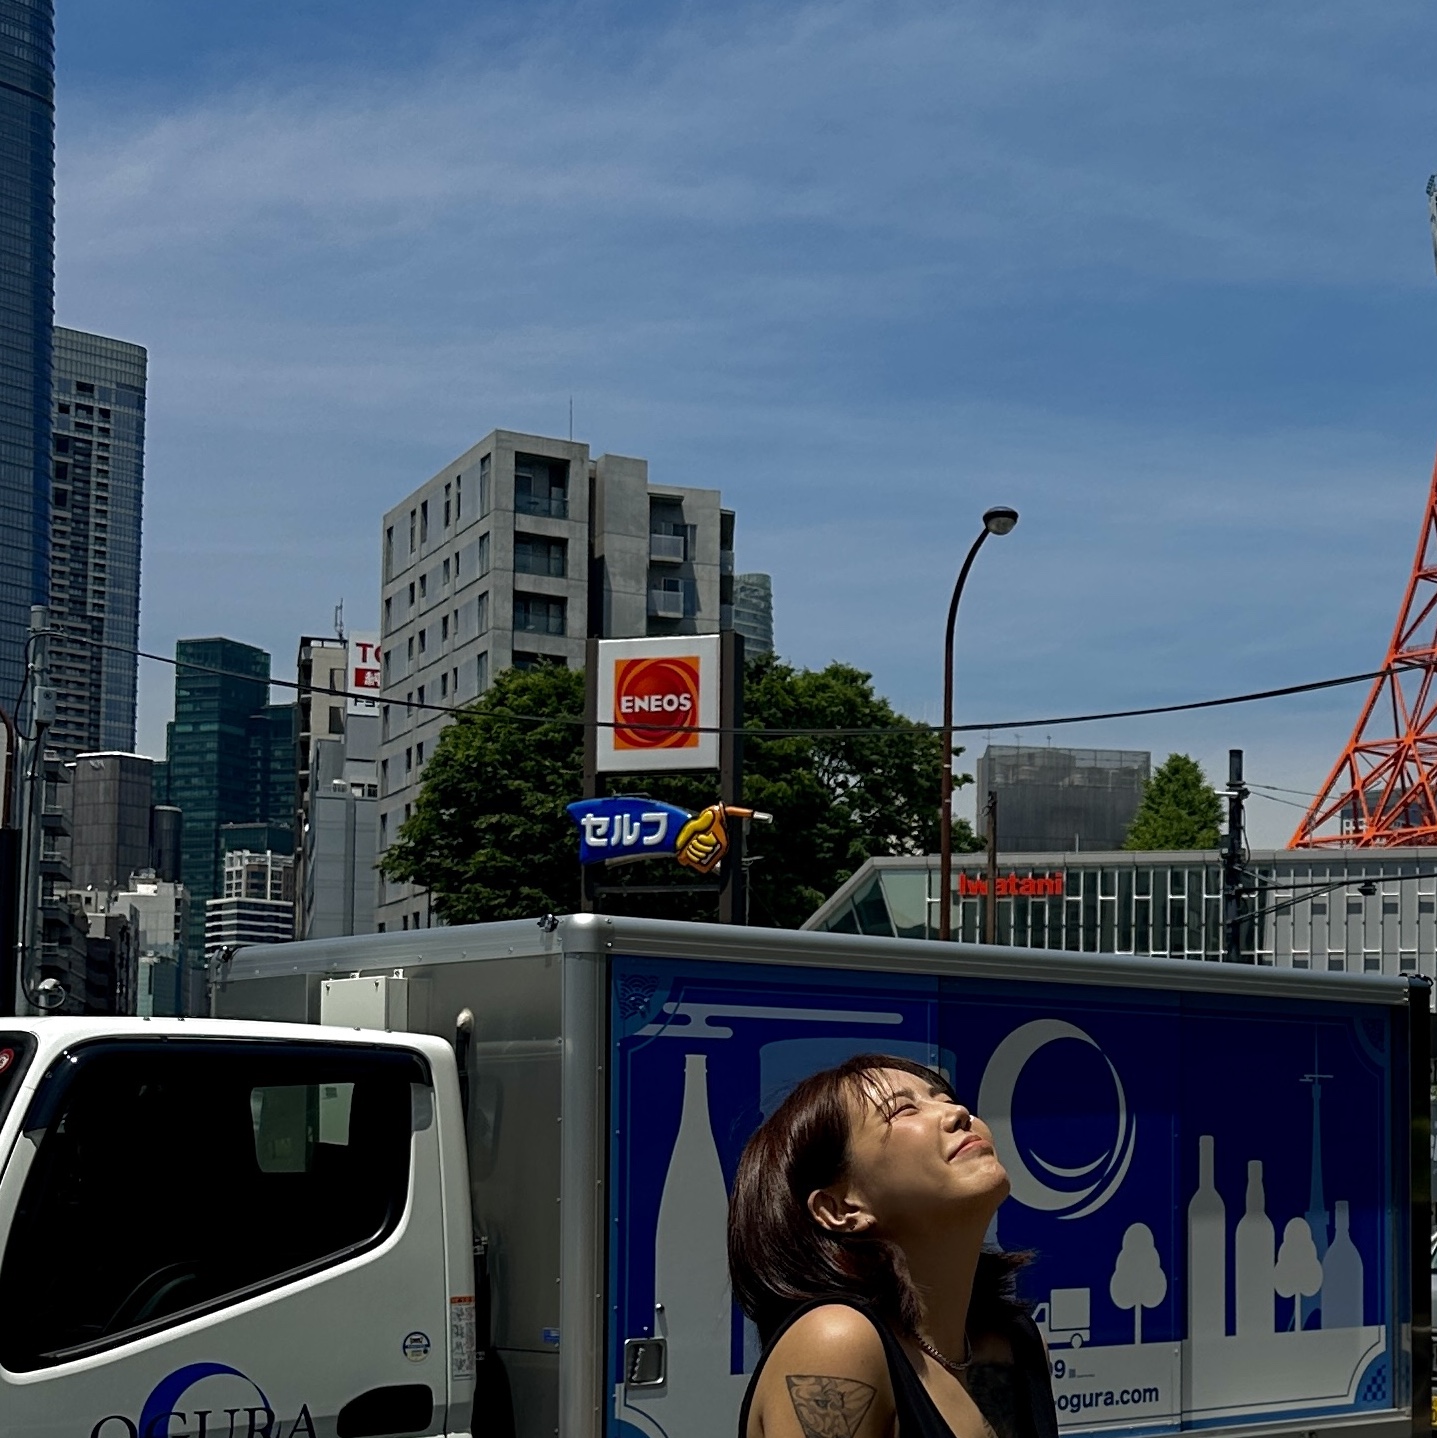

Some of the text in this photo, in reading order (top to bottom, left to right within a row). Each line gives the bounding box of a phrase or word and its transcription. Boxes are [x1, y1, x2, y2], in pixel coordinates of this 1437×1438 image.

[620, 692, 693, 714] ENEOS
[580, 812, 669, 848] セルフ
[958, 871, 1064, 896] Iwatani
